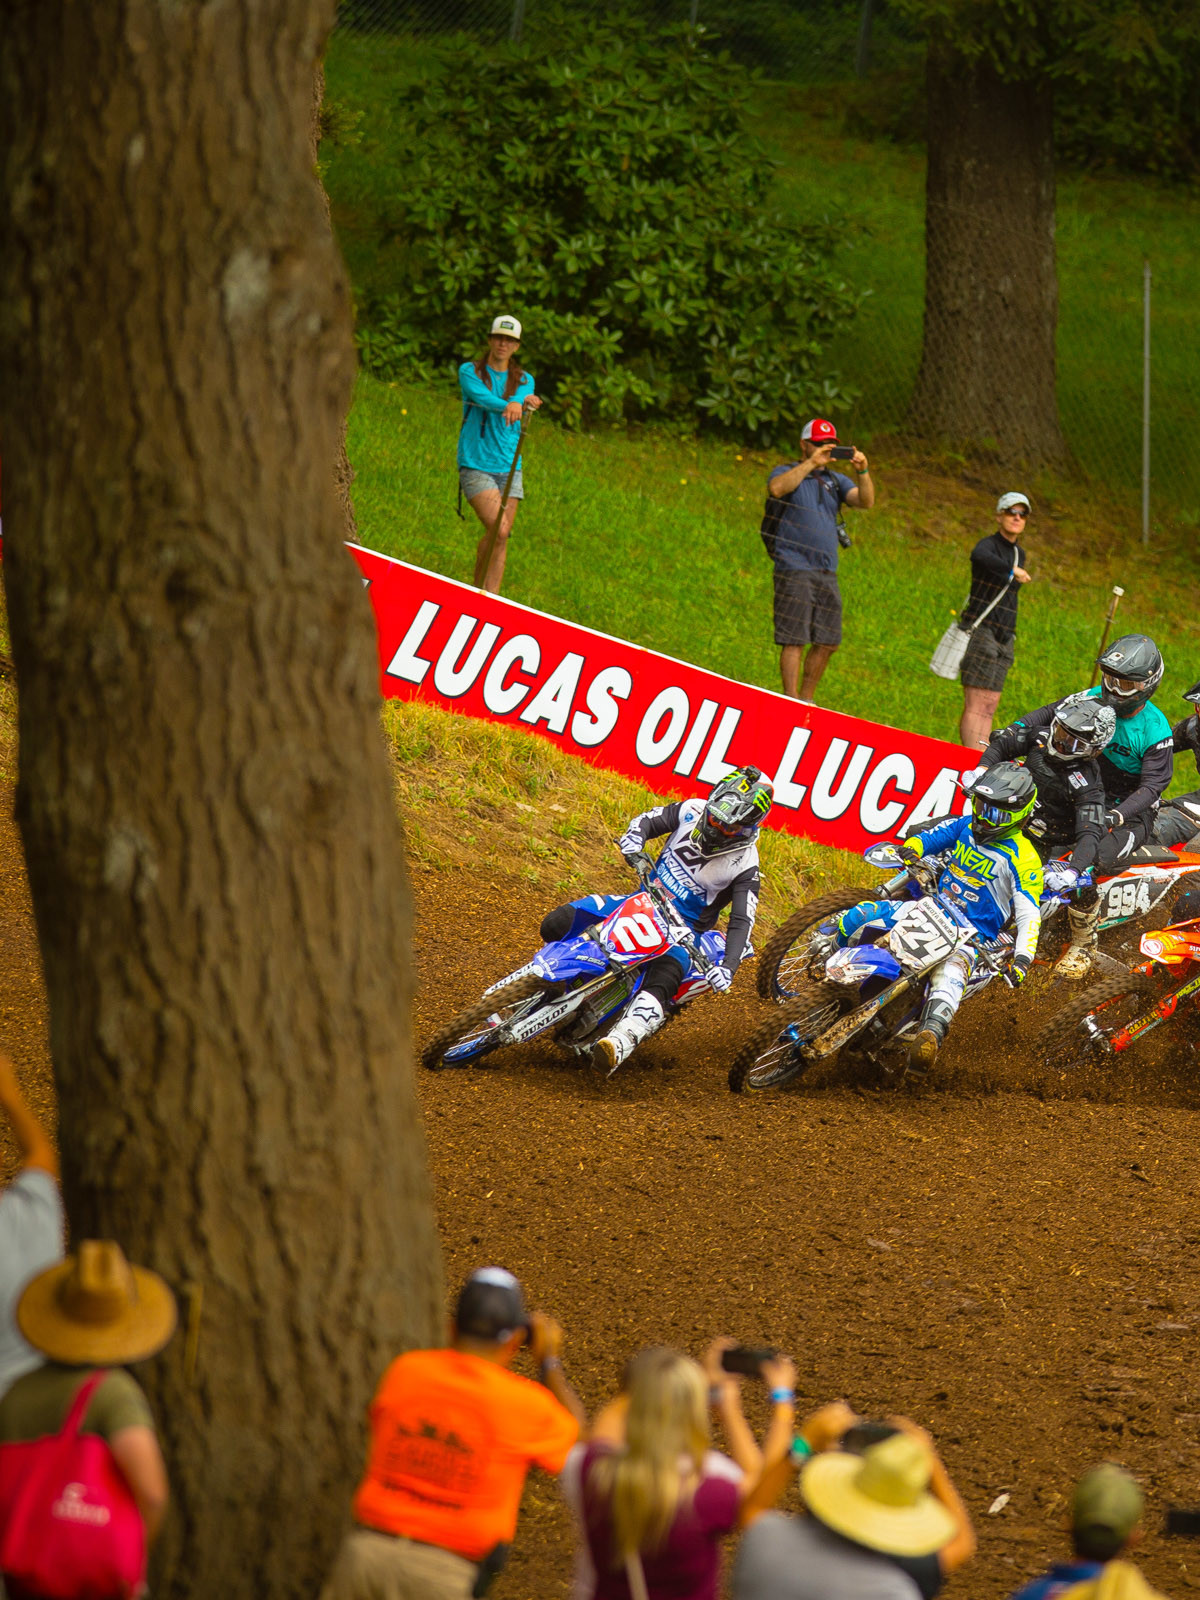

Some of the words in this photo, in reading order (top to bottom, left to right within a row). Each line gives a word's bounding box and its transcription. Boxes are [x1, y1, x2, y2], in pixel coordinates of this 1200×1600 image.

[385, 600, 633, 748] LUCAS
[635, 686, 743, 786] OIL
[770, 726, 973, 840] LUCA
[659, 868, 690, 901] YAMAHA
[611, 912, 663, 952] 2
[897, 908, 953, 961] 224
[520, 1003, 569, 1040] DUNLOP
